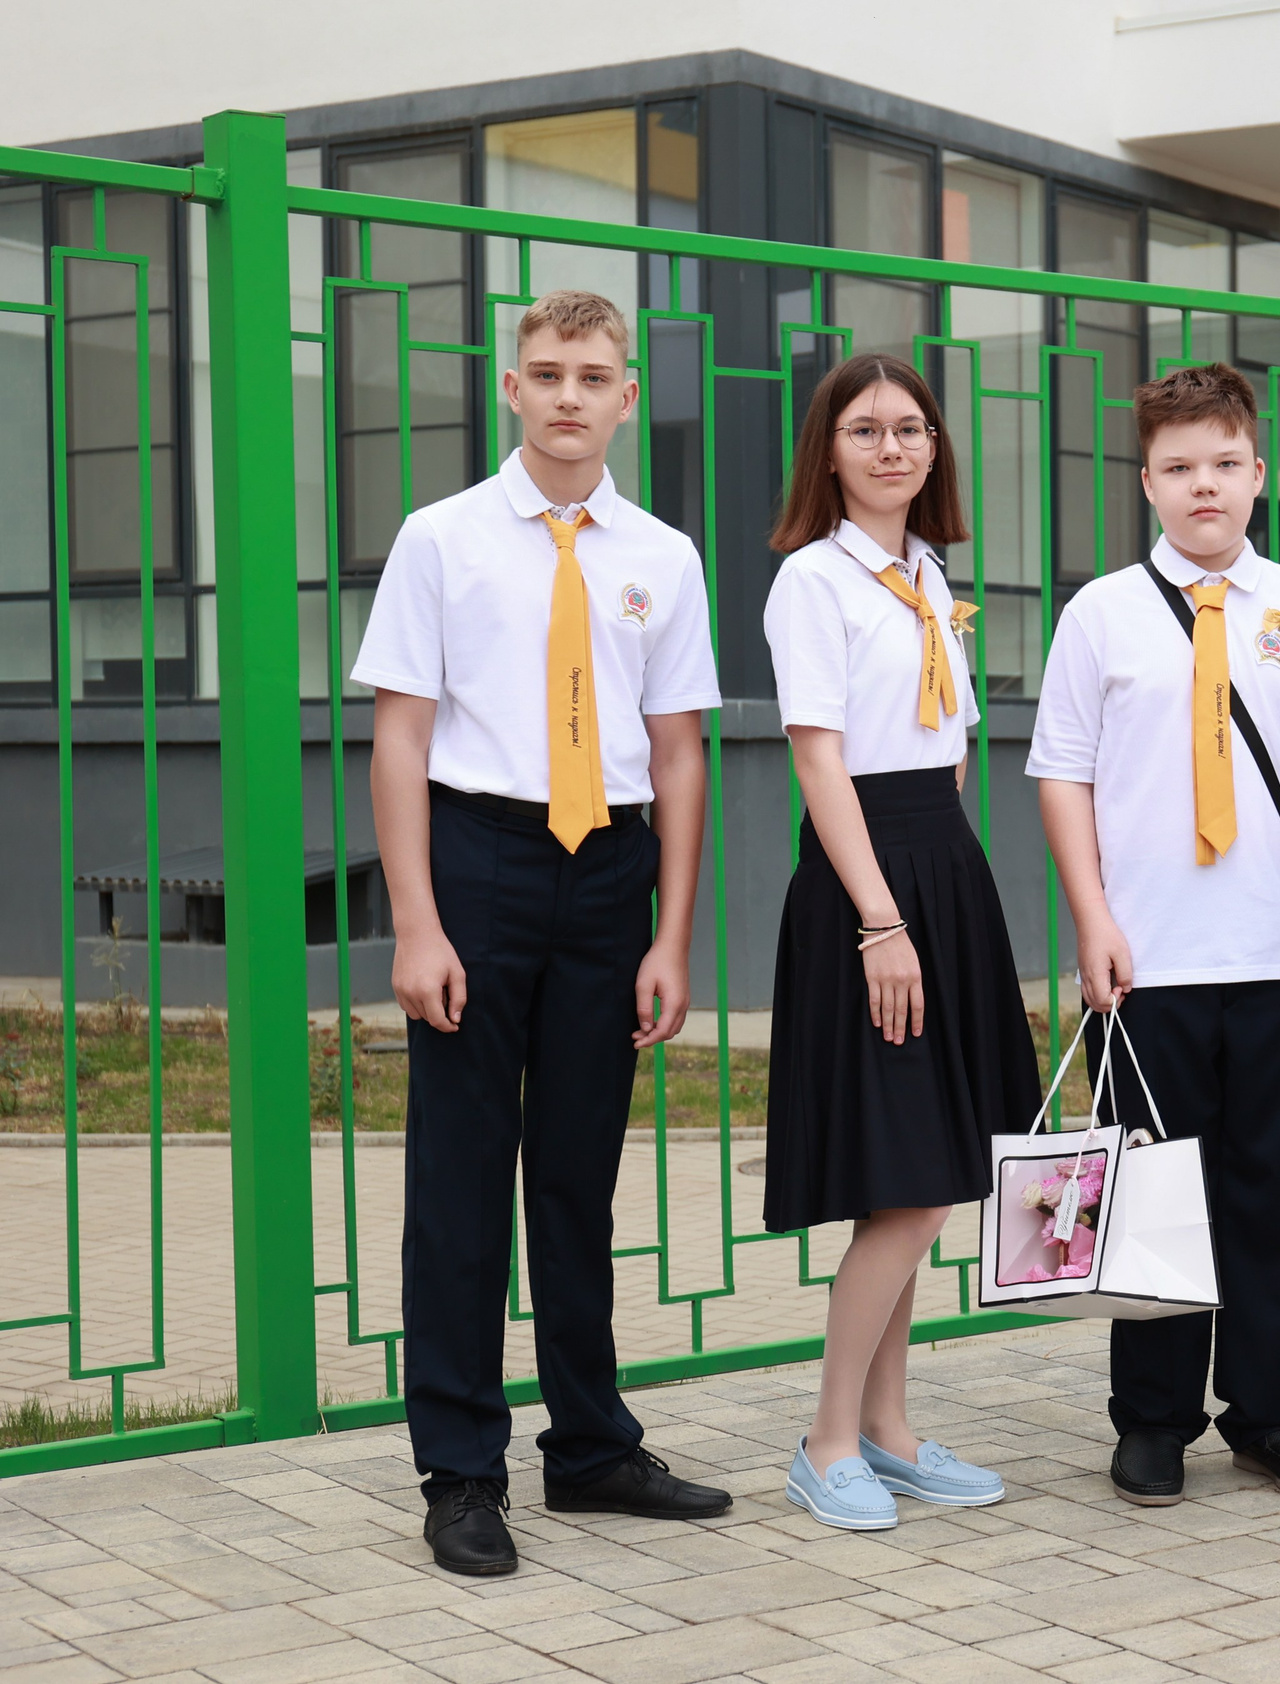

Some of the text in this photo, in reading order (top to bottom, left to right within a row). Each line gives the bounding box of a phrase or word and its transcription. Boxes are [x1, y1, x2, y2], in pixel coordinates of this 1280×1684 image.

[569, 667, 582, 704] Стремись
[1214, 683, 1225, 717] Стремись
[568, 715, 582, 748] наукам!
[1215, 727, 1226, 759] наукам!
